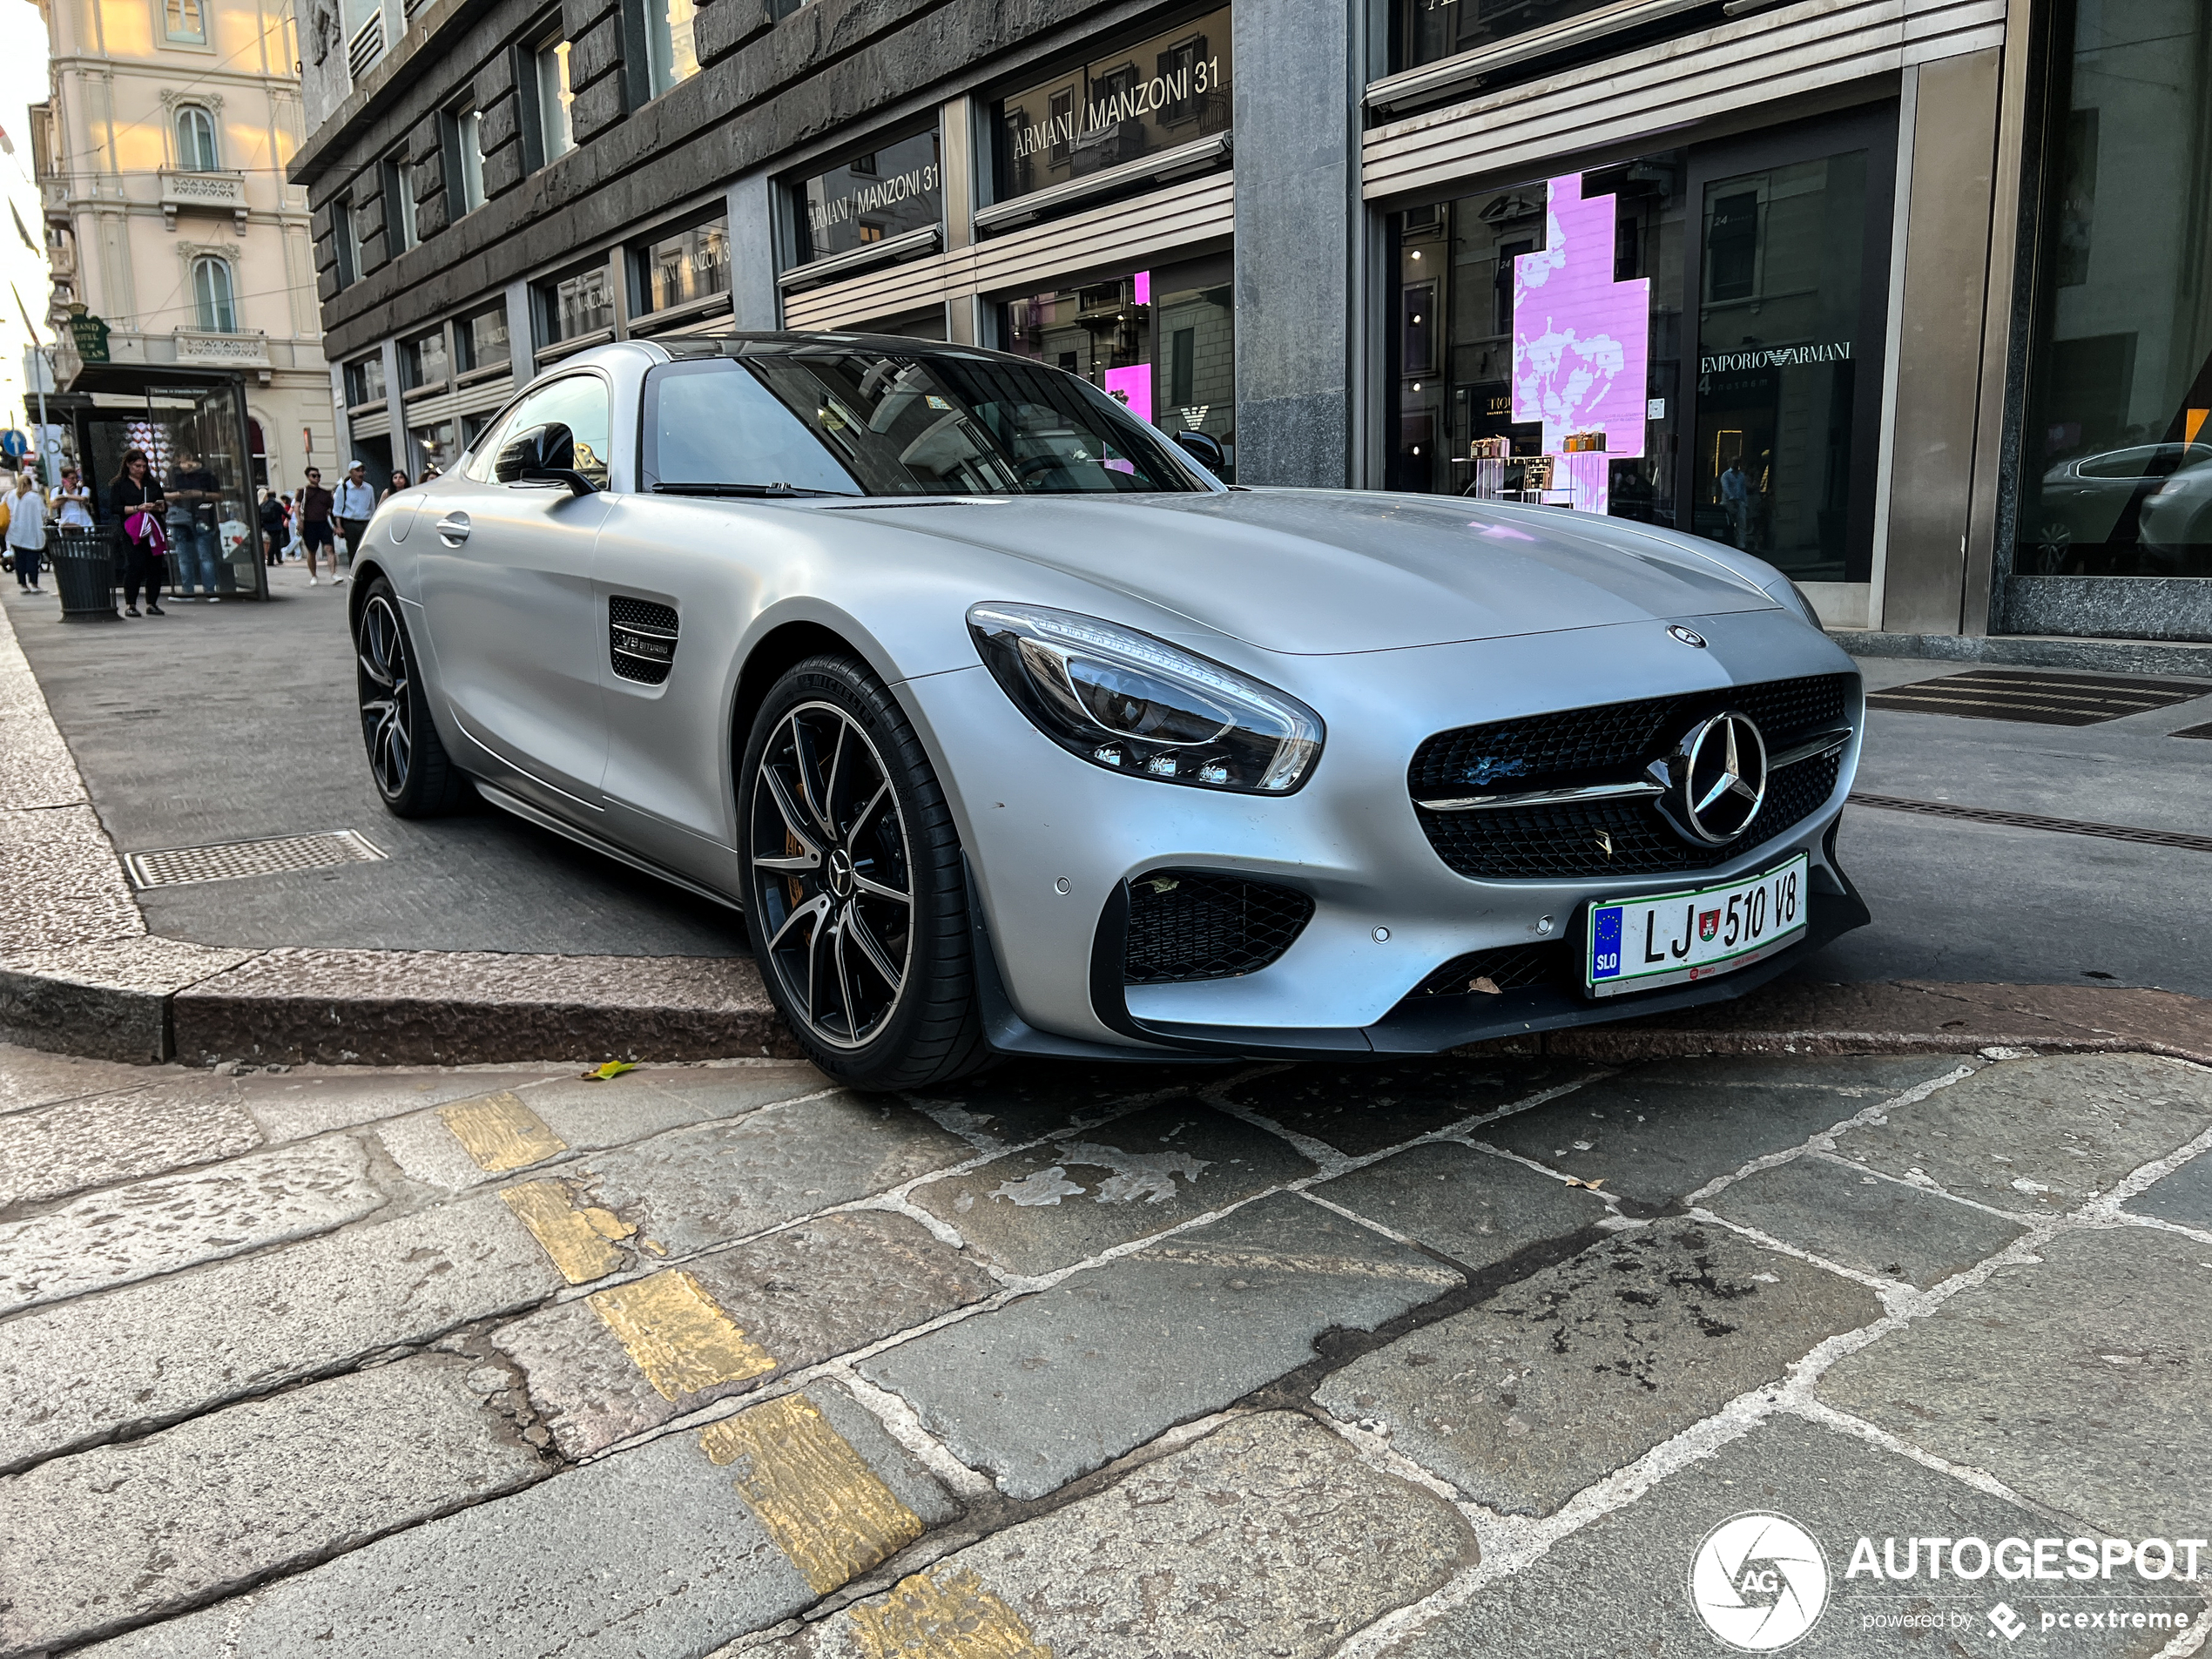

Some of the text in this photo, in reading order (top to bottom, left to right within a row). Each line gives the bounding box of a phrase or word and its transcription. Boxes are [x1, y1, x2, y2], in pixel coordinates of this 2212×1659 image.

[1013, 111, 1073, 159] ARMANI
[1089, 68, 1187, 132] MANZONI
[1195, 56, 1217, 94] 31
[810, 196, 848, 232] ARMANI
[857, 169, 920, 215] MANZONI
[923, 163, 939, 192] 31
[685, 244, 722, 274] ANZONI
[724, 241, 731, 262] 3
[1701, 341, 1851, 374] EMPORIO ARMANI
[812, 675, 873, 724] MICHELIN
[1644, 871, 1796, 963] LJ 510 V8
[1596, 953, 1617, 970] SLO
